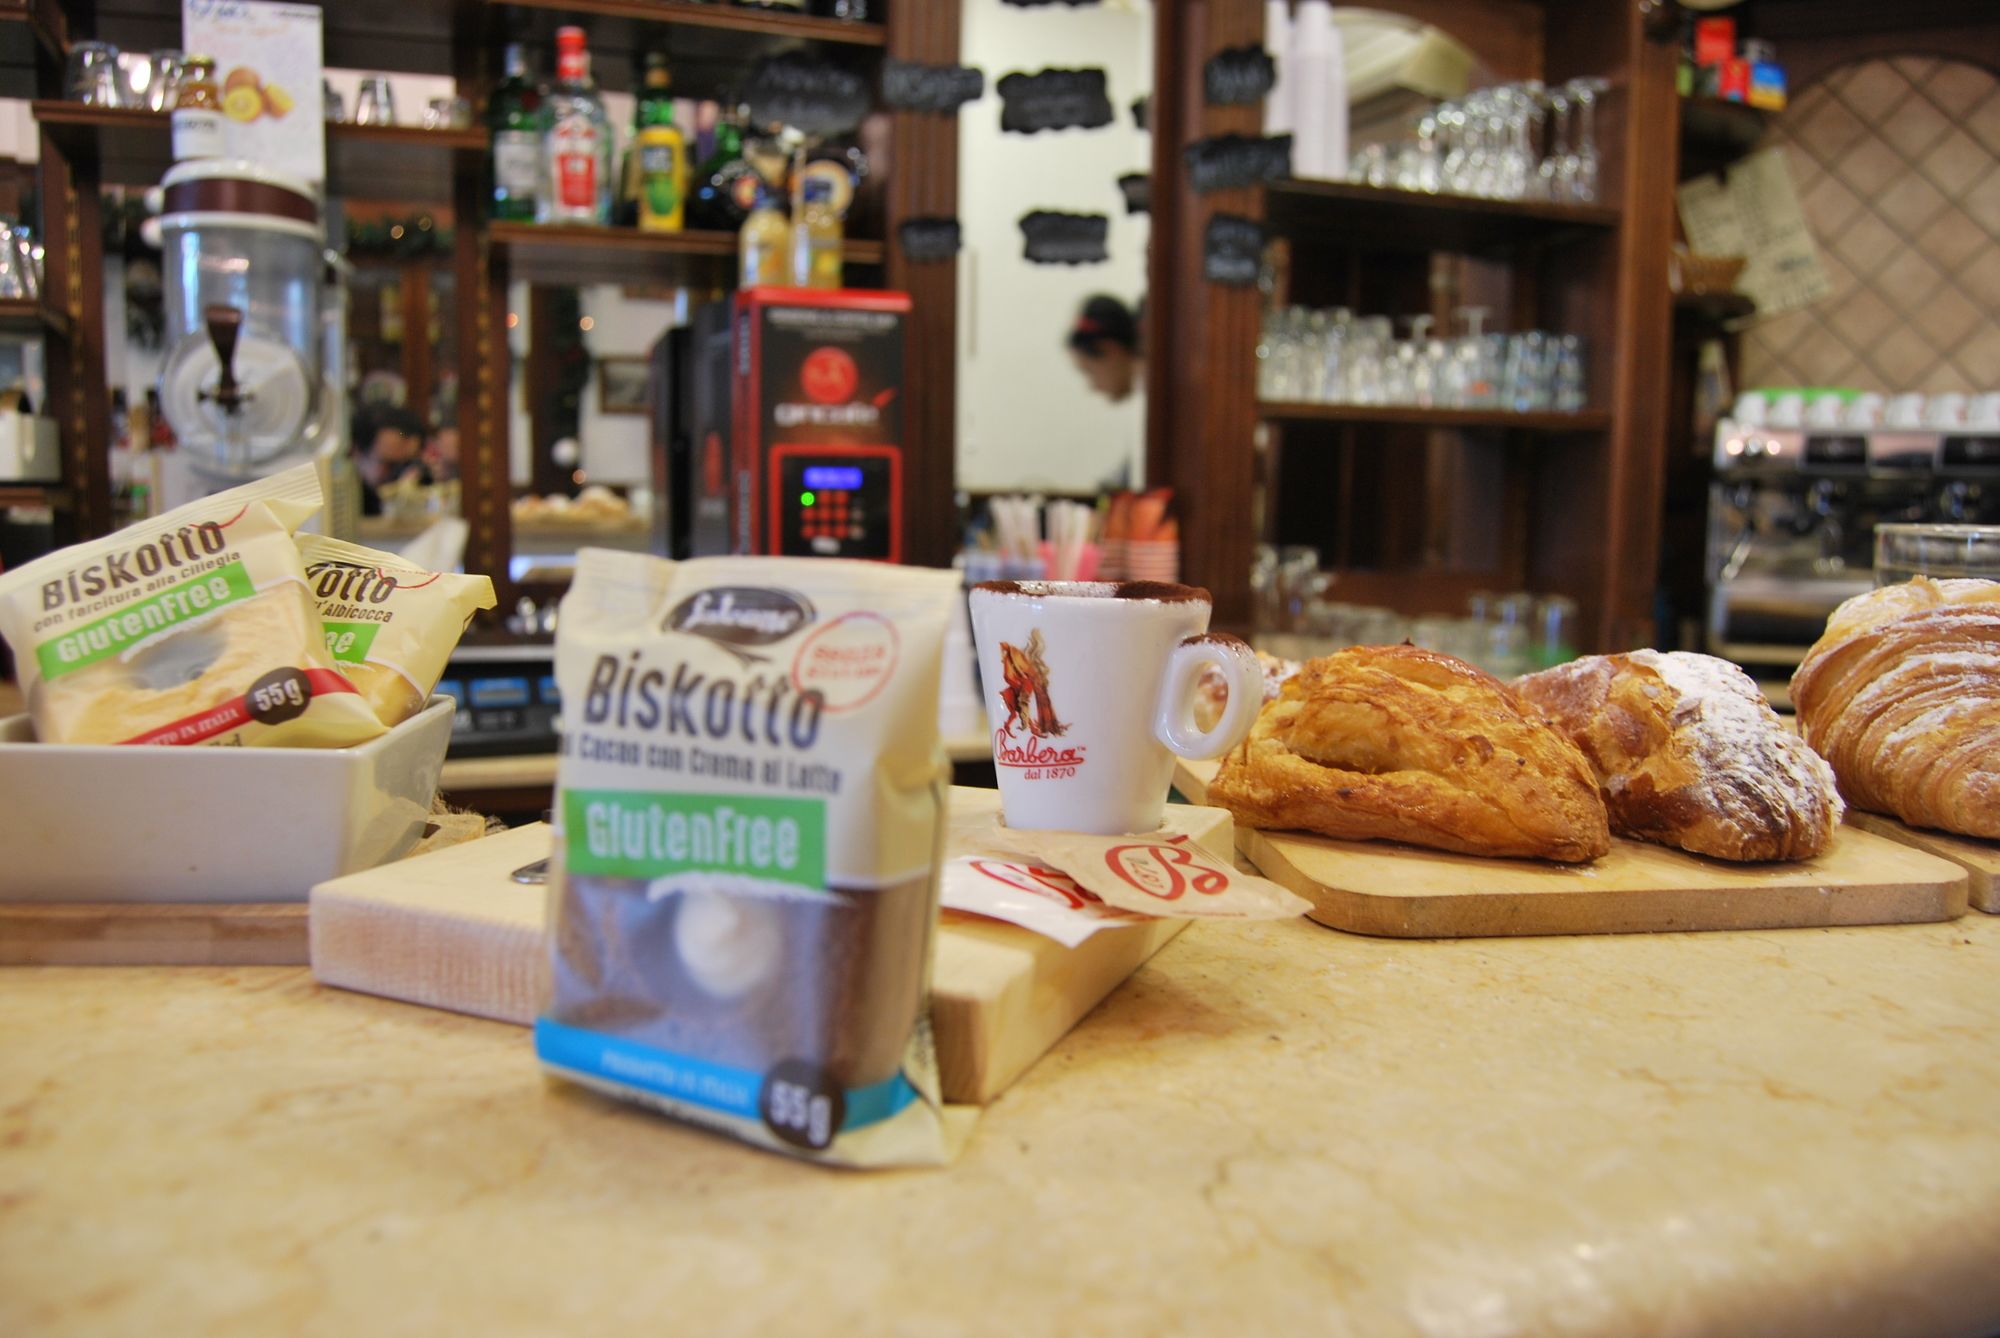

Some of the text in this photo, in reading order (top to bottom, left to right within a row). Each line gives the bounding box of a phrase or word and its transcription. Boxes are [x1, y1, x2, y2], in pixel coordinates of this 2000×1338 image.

[34, 612, 63, 633] con
[68, 587, 142, 621] farcitura
[147, 573, 177, 592] alla
[57, 576, 231, 663] GlutenFree
[254, 677, 305, 711] 55g
[198, 707, 239, 733] ITALIA
[648, 744, 684, 773] con
[995, 728, 1084, 768] Barbera
[1024, 767, 1075, 780] dal 1870
[585, 800, 799, 870] GlutenFree
[769, 1079, 832, 1147] 55g
